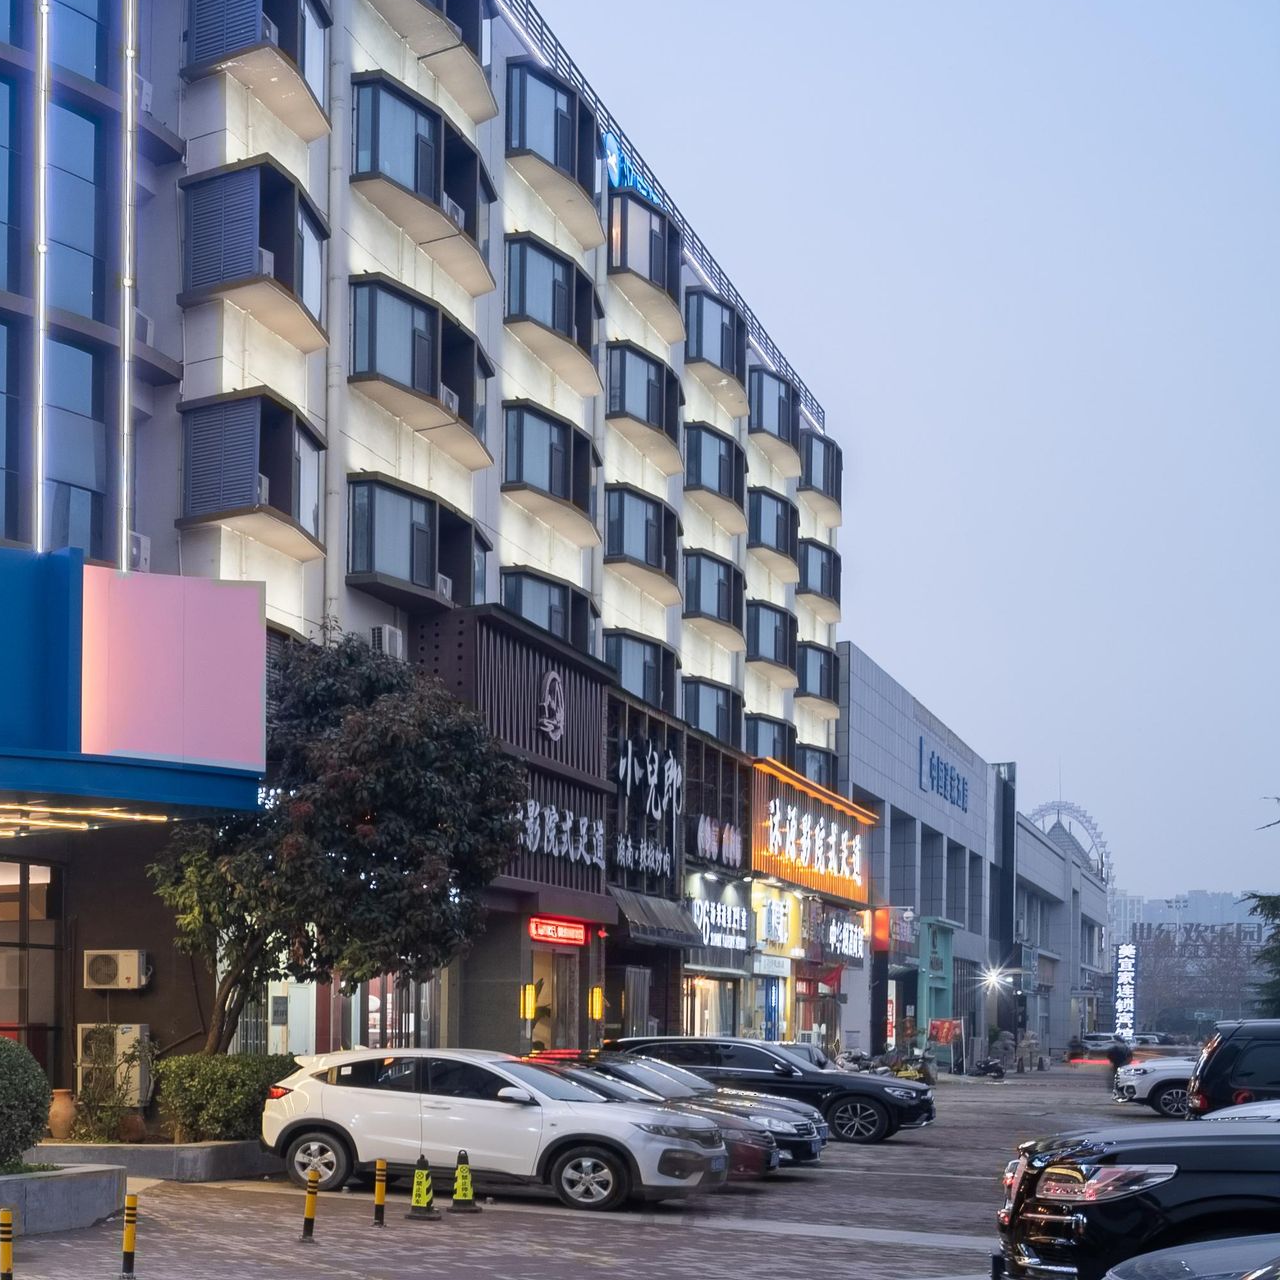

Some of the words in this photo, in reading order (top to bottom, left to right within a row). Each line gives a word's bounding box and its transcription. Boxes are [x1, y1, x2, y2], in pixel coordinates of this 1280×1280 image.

[1114, 943, 1137, 1040] 美宜家连锁宾馆
